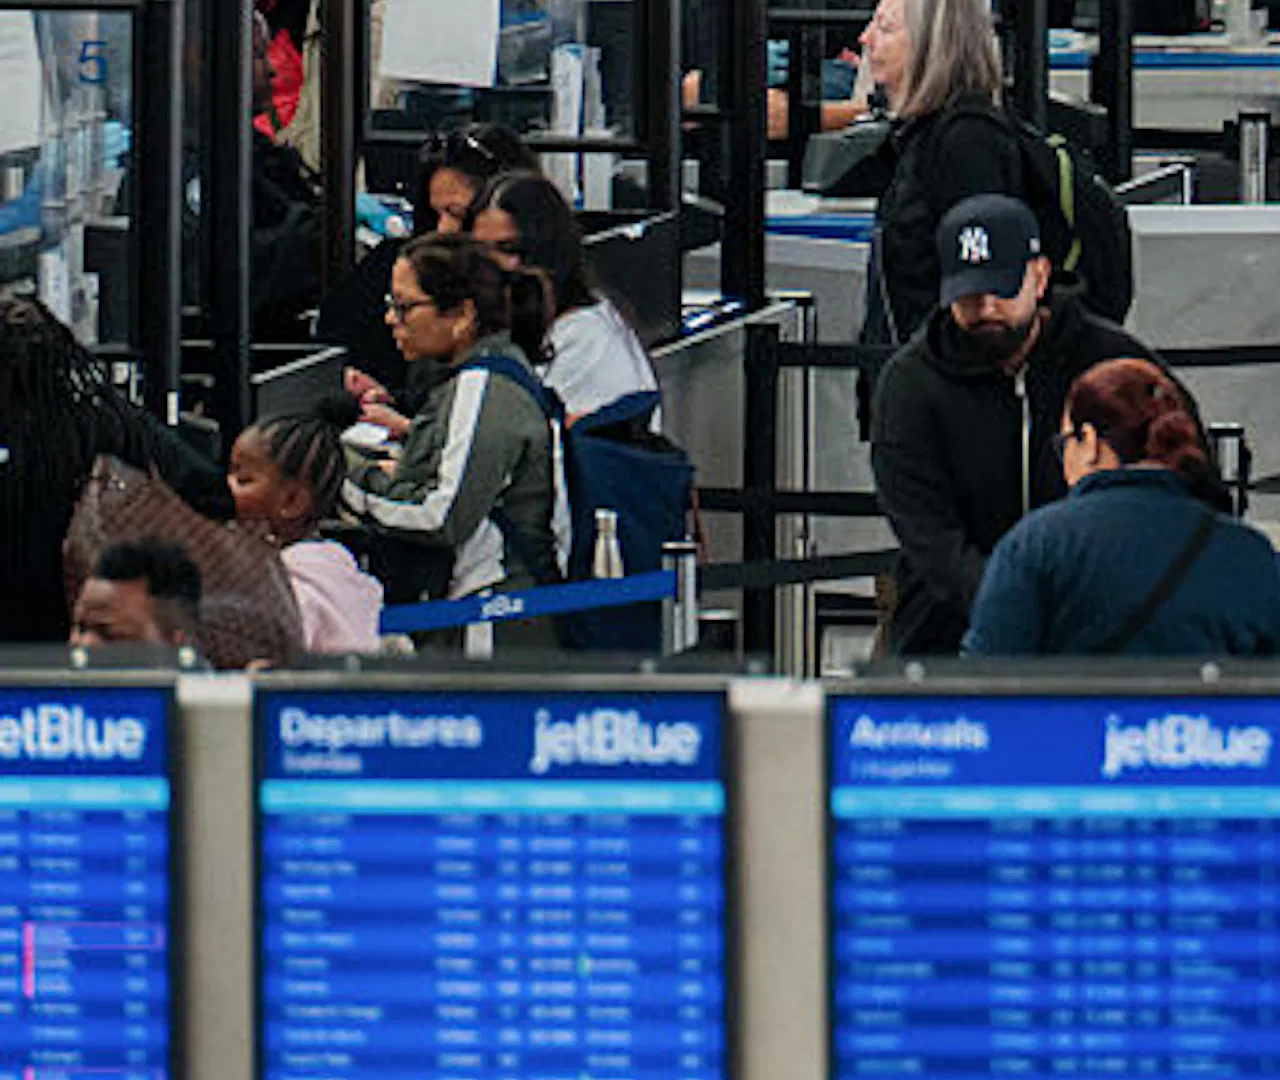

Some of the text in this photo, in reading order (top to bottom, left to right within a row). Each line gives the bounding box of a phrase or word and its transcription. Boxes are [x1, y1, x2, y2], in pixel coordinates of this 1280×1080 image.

[79, 40, 108, 84] 5
[0, 703, 147, 761] etBlue
[280, 706, 482, 750] Departures
[529, 707, 702, 774] jetBlue
[850, 713, 991, 752] Arrivals
[1101, 713, 1273, 780] jetBlue
